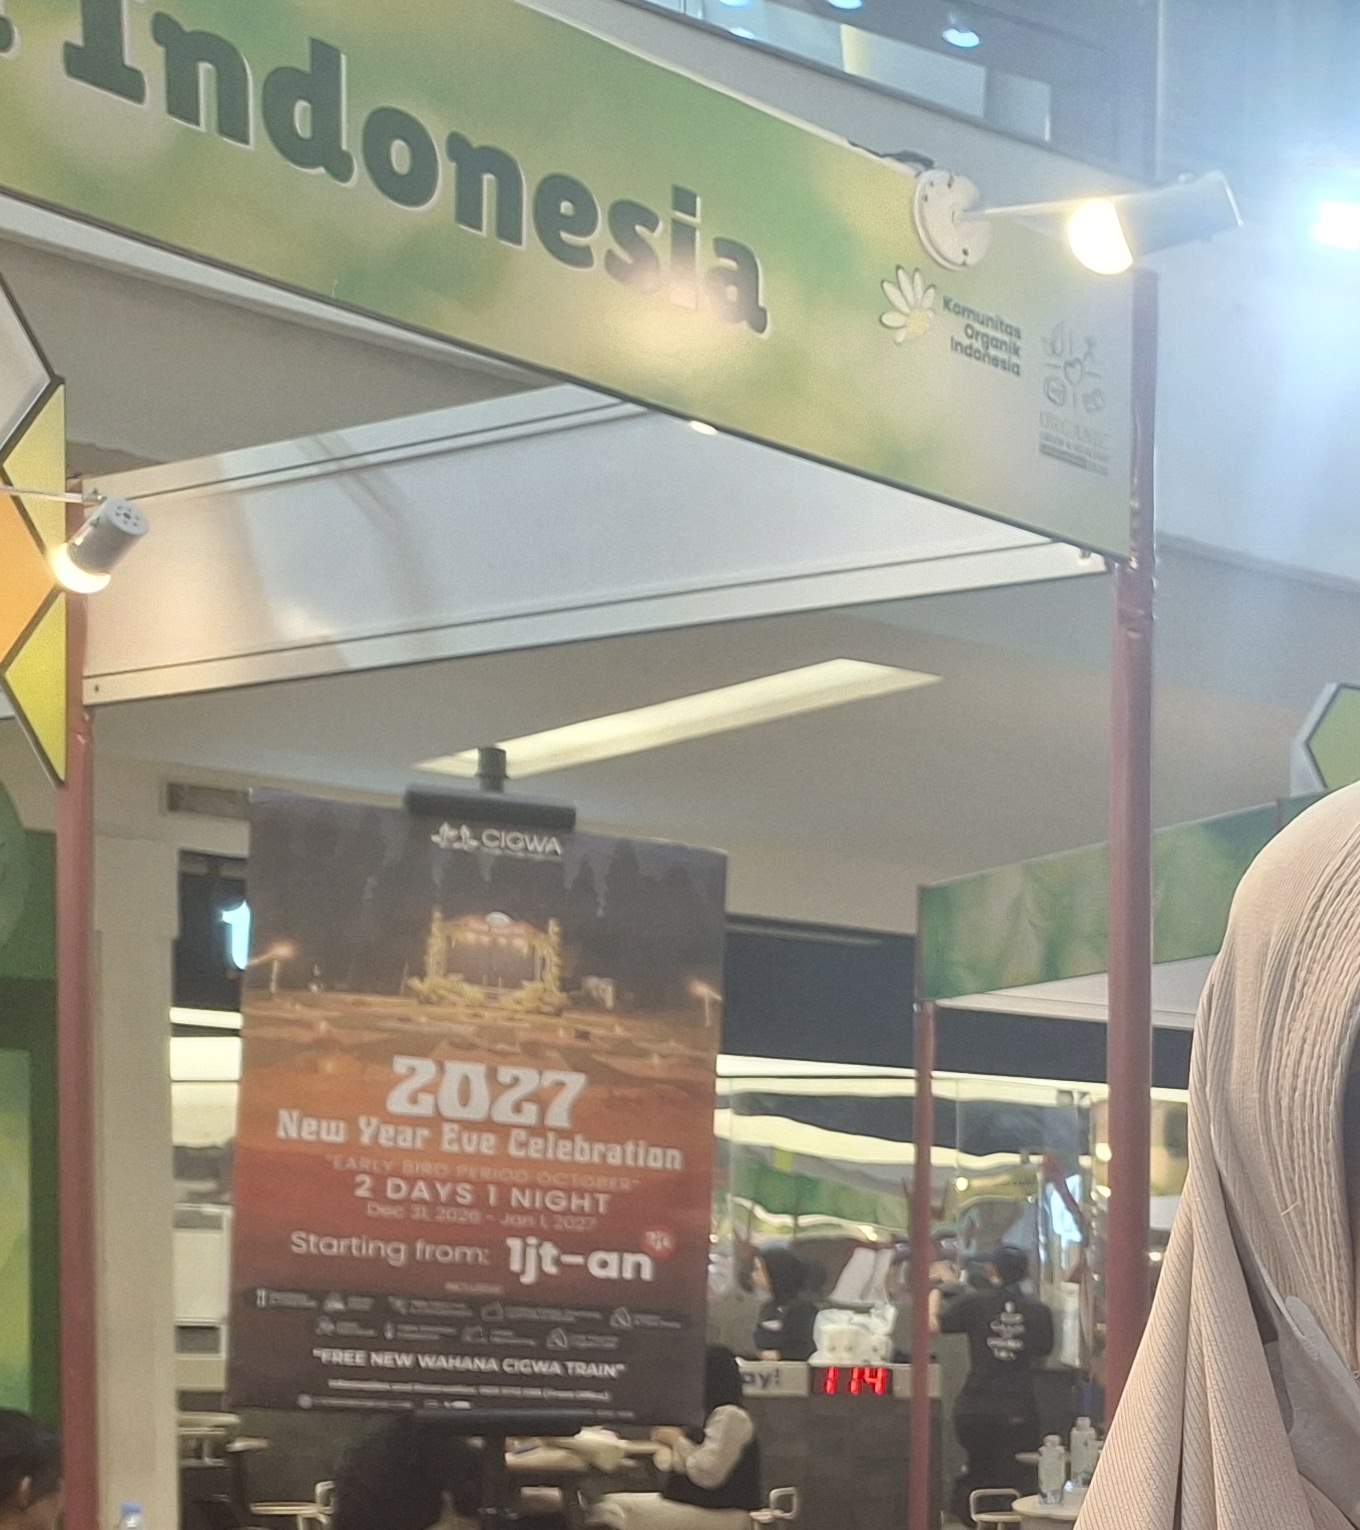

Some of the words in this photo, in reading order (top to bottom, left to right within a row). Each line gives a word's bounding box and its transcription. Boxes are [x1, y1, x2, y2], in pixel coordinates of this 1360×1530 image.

[64, 0, 768, 334] Indonesia
[942, 296, 1022, 340] Komunitas
[951, 336, 1021, 376] Indonesia
[964, 323, 1021, 359] Organik
[481, 828, 562, 856] CIGWA
[385, 1055, 588, 1129] 2027
[276, 1107, 347, 1144] New
[357, 1114, 430, 1150] Year
[440, 1122, 497, 1156] Eve
[507, 1127, 684, 1171] Celebration
[353, 1174, 373, 1198] 2
[386, 1177, 474, 1206] DAYS
[487, 1183, 498, 1208] 1
[509, 1186, 611, 1216] NIGHT
[291, 1230, 406, 1266] Starting
[414, 1239, 491, 1266] from:
[313, 1347, 367, 1367] "FREE
[369, 1351, 416, 1369] NEW
[417, 1353, 499, 1373] WAHANA
